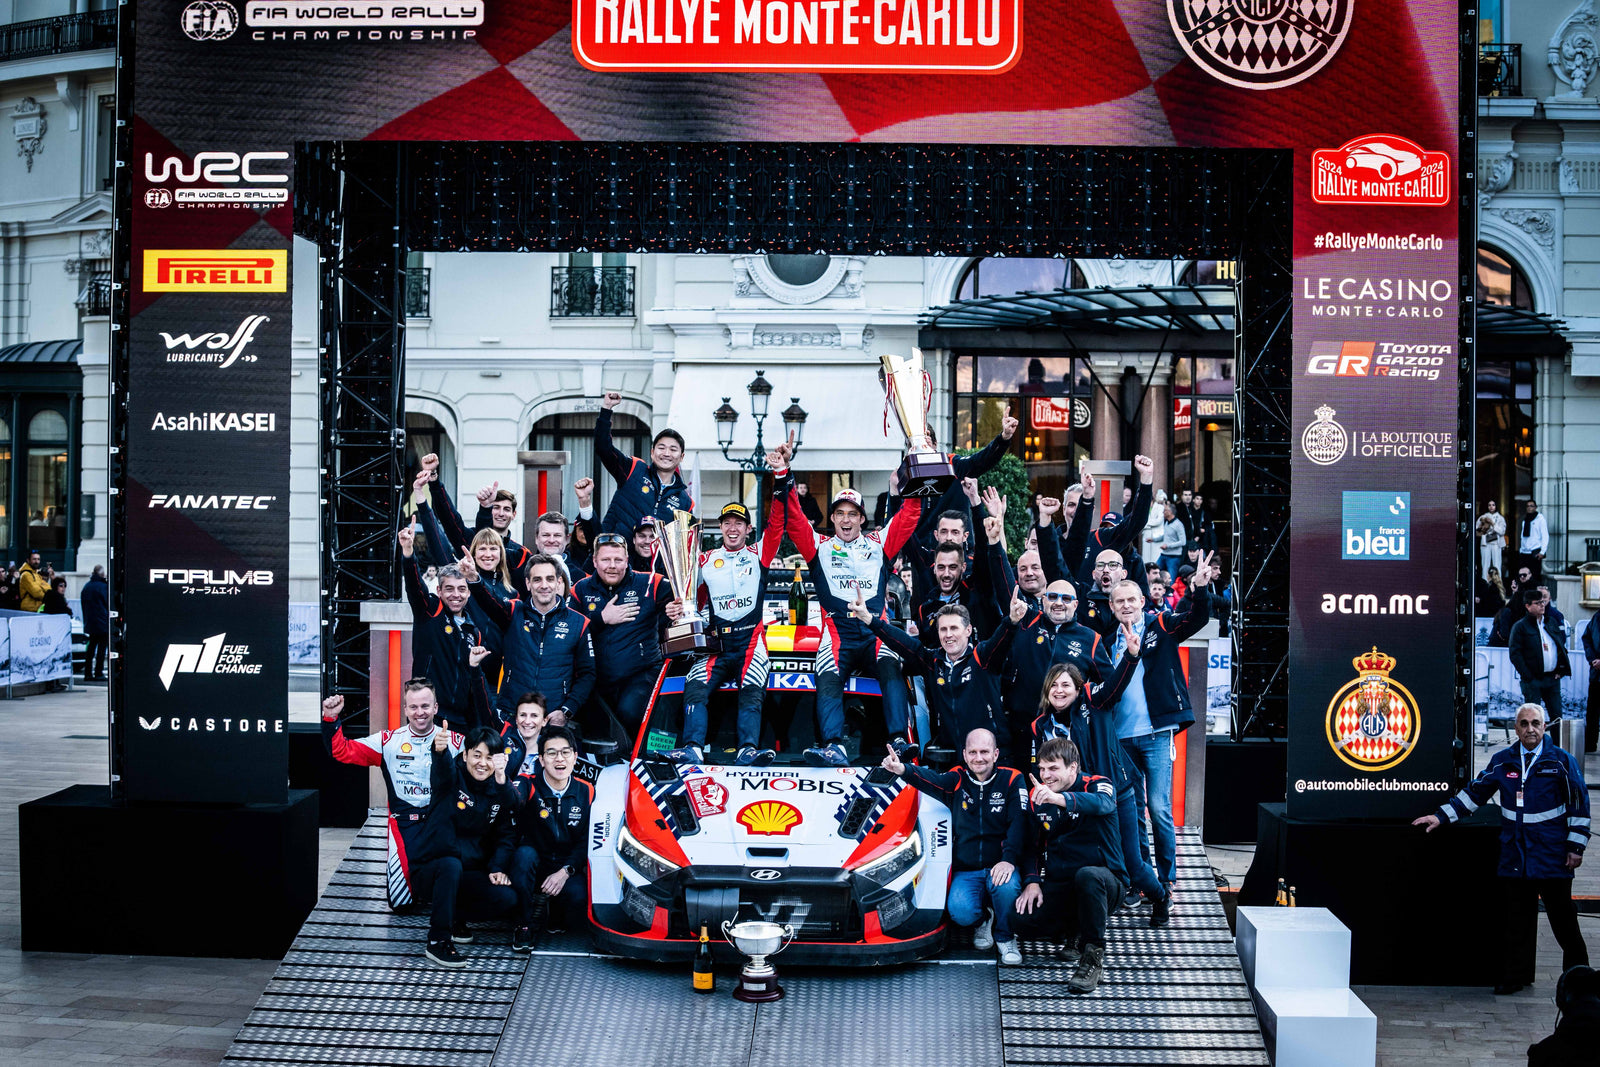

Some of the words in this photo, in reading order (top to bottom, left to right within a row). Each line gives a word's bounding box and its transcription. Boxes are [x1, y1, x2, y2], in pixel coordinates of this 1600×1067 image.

[253, 7, 288, 19] FIA
[296, 7, 382, 19] WORLD
[391, 6, 477, 19] RALLY
[252, 30, 477, 41] CHAMPIONSHIP
[145, 152, 290, 183] WRC
[1318, 157, 1343, 176] 2024
[1420, 160, 1444, 177] 2024
[1318, 168, 1358, 197] RALLYE
[1314, 232, 1444, 252] #RallyeMonteCarlo
[157, 258, 275, 284] PIRELLI
[1304, 278, 1332, 299] LE
[1338, 278, 1452, 301] CASINO
[1378, 343, 1452, 355] TOYOTA
[166, 353, 225, 363] LUBRICANTS
[1307, 355, 1369, 376] GR
[1376, 356, 1444, 366] GAZOO
[1373, 366, 1440, 381] Racing
[151, 411, 276, 431] AsahiKASEI
[1362, 432, 1379, 444] LA
[1382, 432, 1452, 447] BOUTIQUE
[1361, 445, 1452, 458] OFFICIELLE
[148, 494, 273, 510] FANATEC
[1379, 526, 1405, 536] france
[1346, 528, 1406, 556] bleu
[149, 568, 273, 585] FORUM8
[182, 585, 241, 595] フォーラムエイト
[718, 596, 753, 611] MOBIS
[1321, 593, 1430, 615] acm.mc
[222, 645, 250, 655] FUEL
[218, 655, 243, 664] FOR
[215, 664, 262, 674] CHANGE
[170, 717, 284, 733] CASTORE
[650, 735, 673, 745] GREEN
[740, 777, 844, 795] MOBIS
[1295, 779, 1449, 792] @automobileclubmonaco
